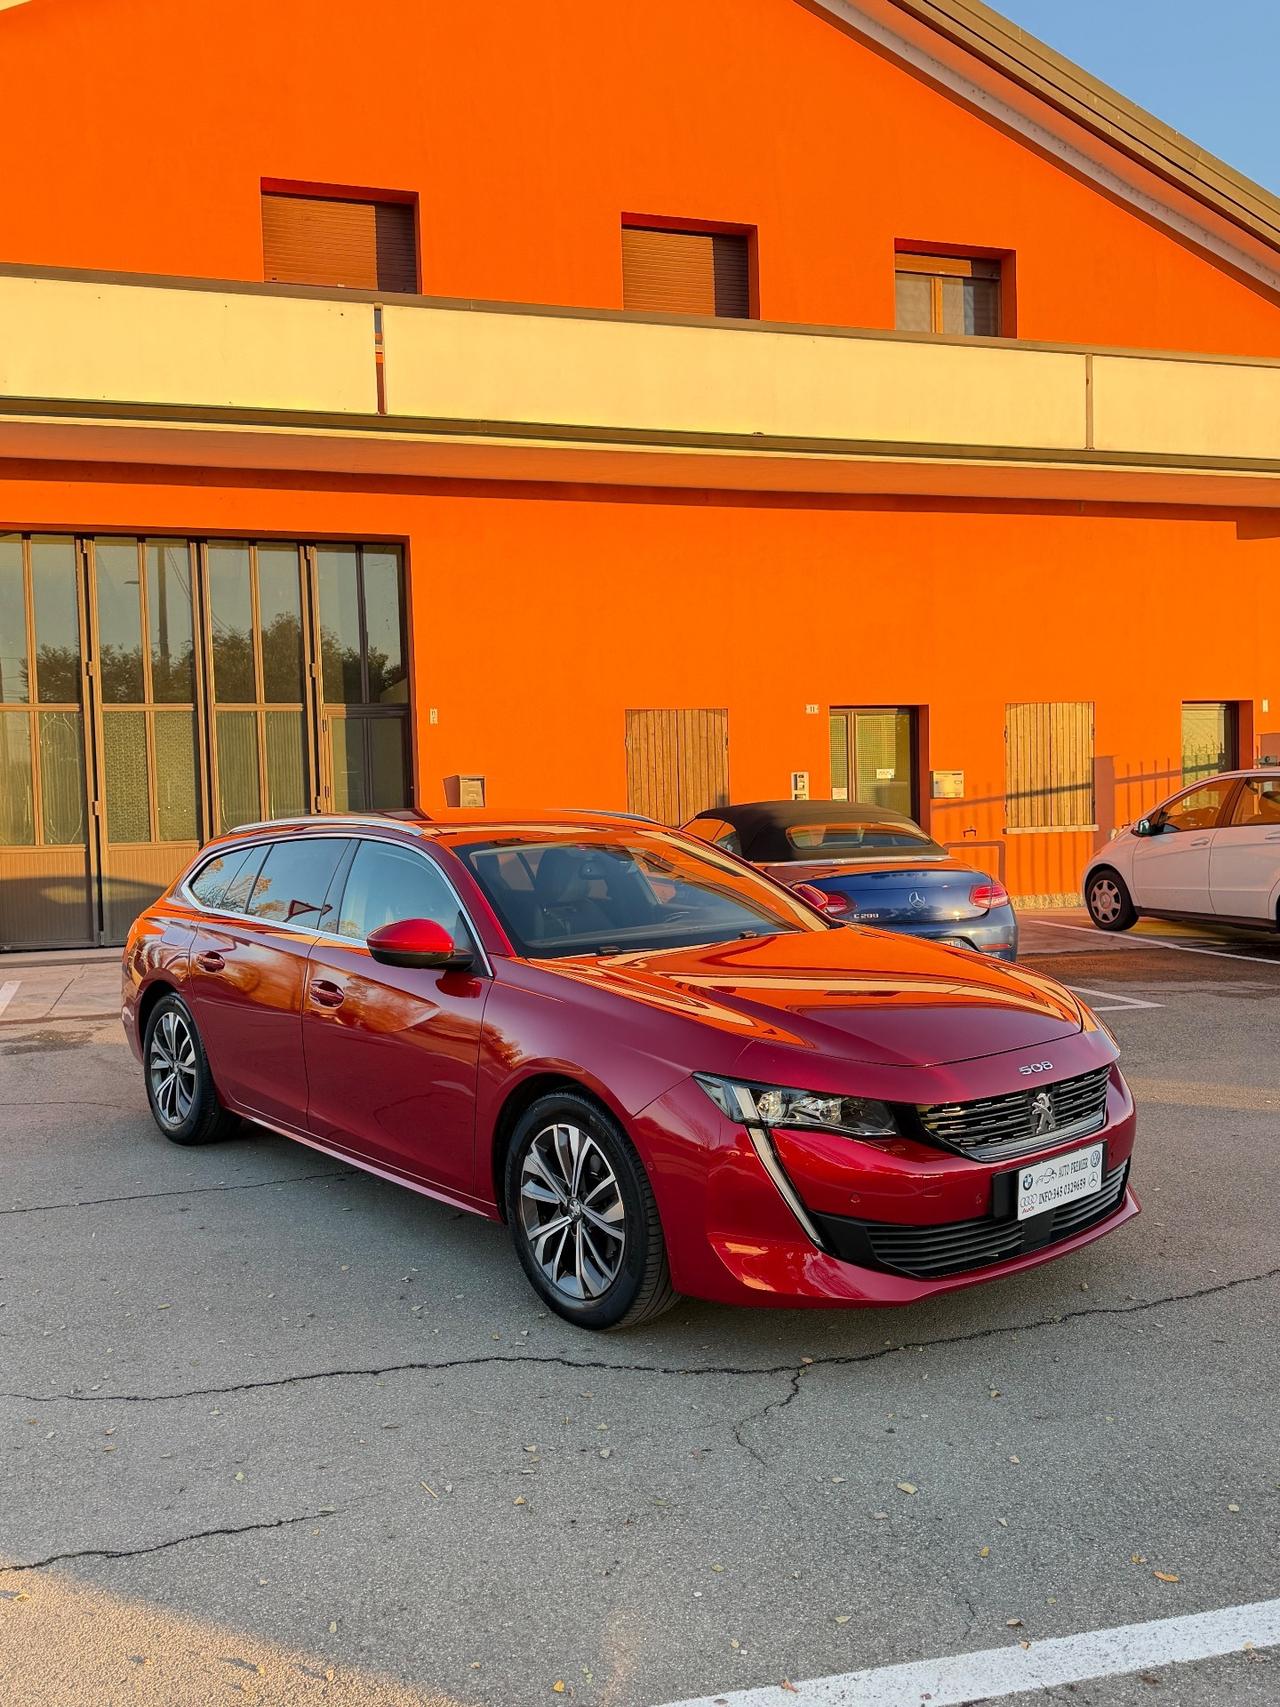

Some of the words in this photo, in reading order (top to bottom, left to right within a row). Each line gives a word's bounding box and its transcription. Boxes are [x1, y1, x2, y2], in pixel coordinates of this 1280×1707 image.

[1018, 1060, 1054, 1075] 508
[1058, 1163, 1070, 1178] AUTO
[1070, 1157, 1088, 1174] PREMIER
